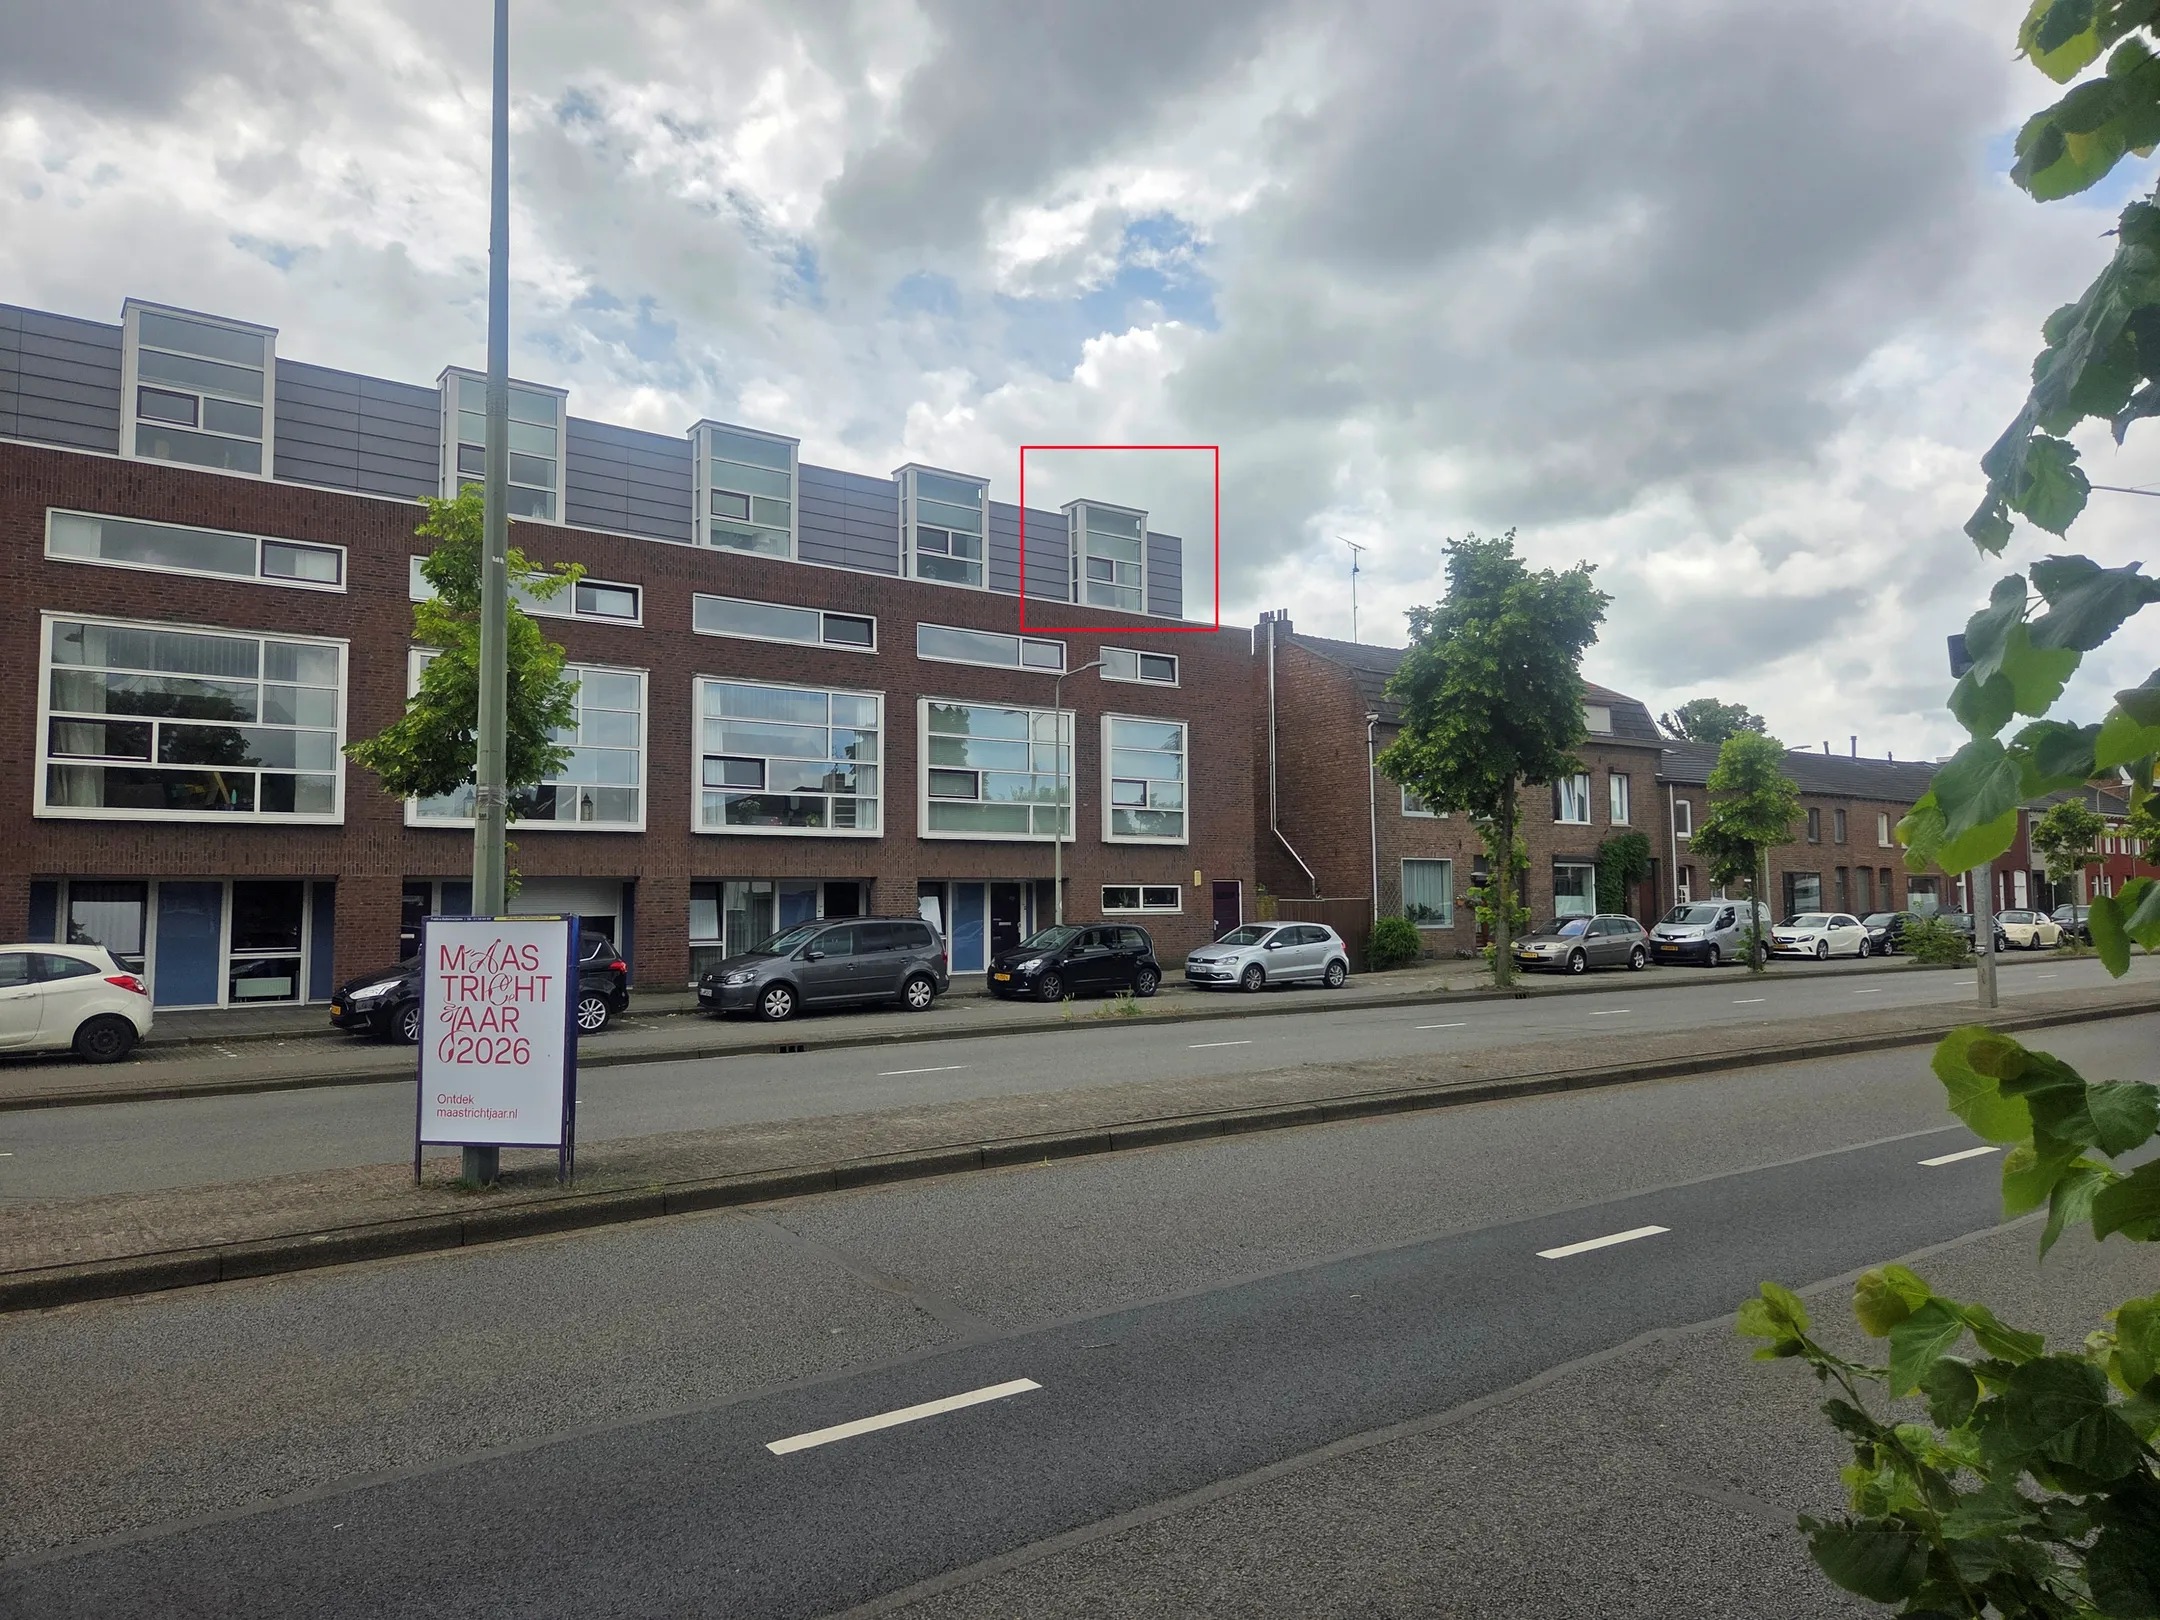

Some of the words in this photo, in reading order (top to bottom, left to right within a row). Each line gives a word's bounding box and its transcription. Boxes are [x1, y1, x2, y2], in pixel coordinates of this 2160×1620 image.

[440, 939, 539, 974] MAAS
[440, 973, 553, 1006] TRICHT
[456, 1036, 530, 1065] 2026
[437, 1093, 474, 1104] Ontdek
[436, 1107, 518, 1120] maastrichtjaar.nl
